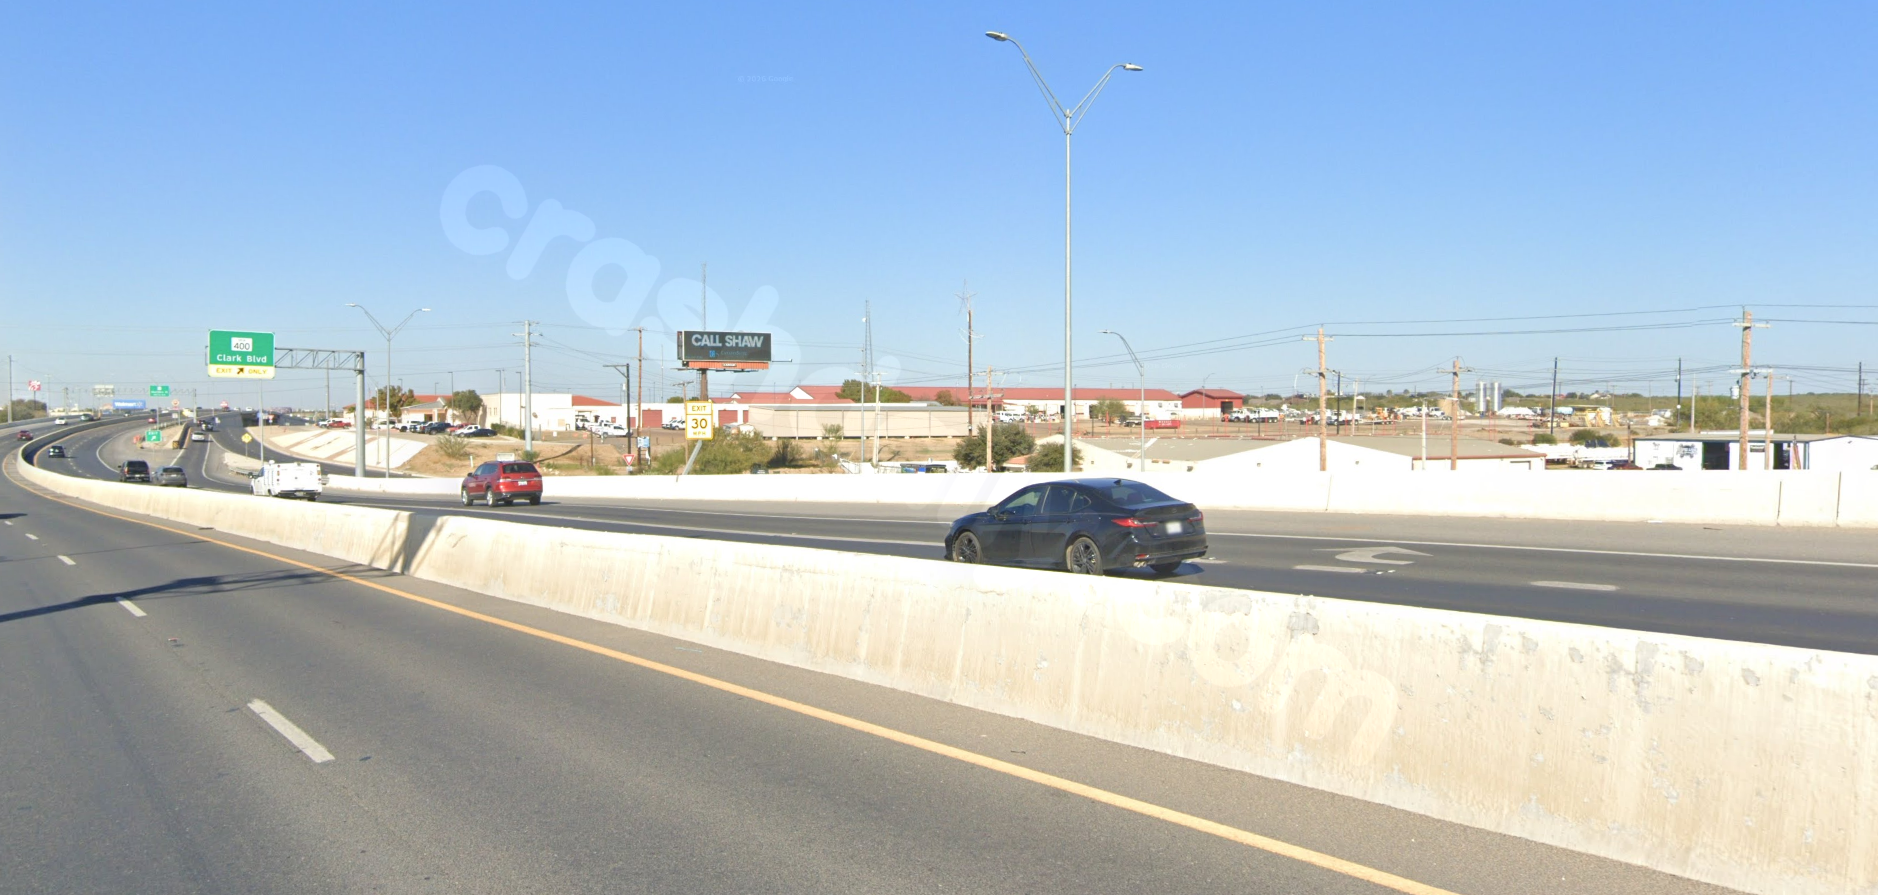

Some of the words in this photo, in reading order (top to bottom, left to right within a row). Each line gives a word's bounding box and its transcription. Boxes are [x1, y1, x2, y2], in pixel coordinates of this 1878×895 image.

[691, 334, 722, 347] CALL
[725, 335, 764, 348] SHAW
[233, 342, 250, 351] 400
[216, 354, 242, 362] Clark
[246, 355, 267, 363] Blvd
[691, 418, 708, 429] 30
